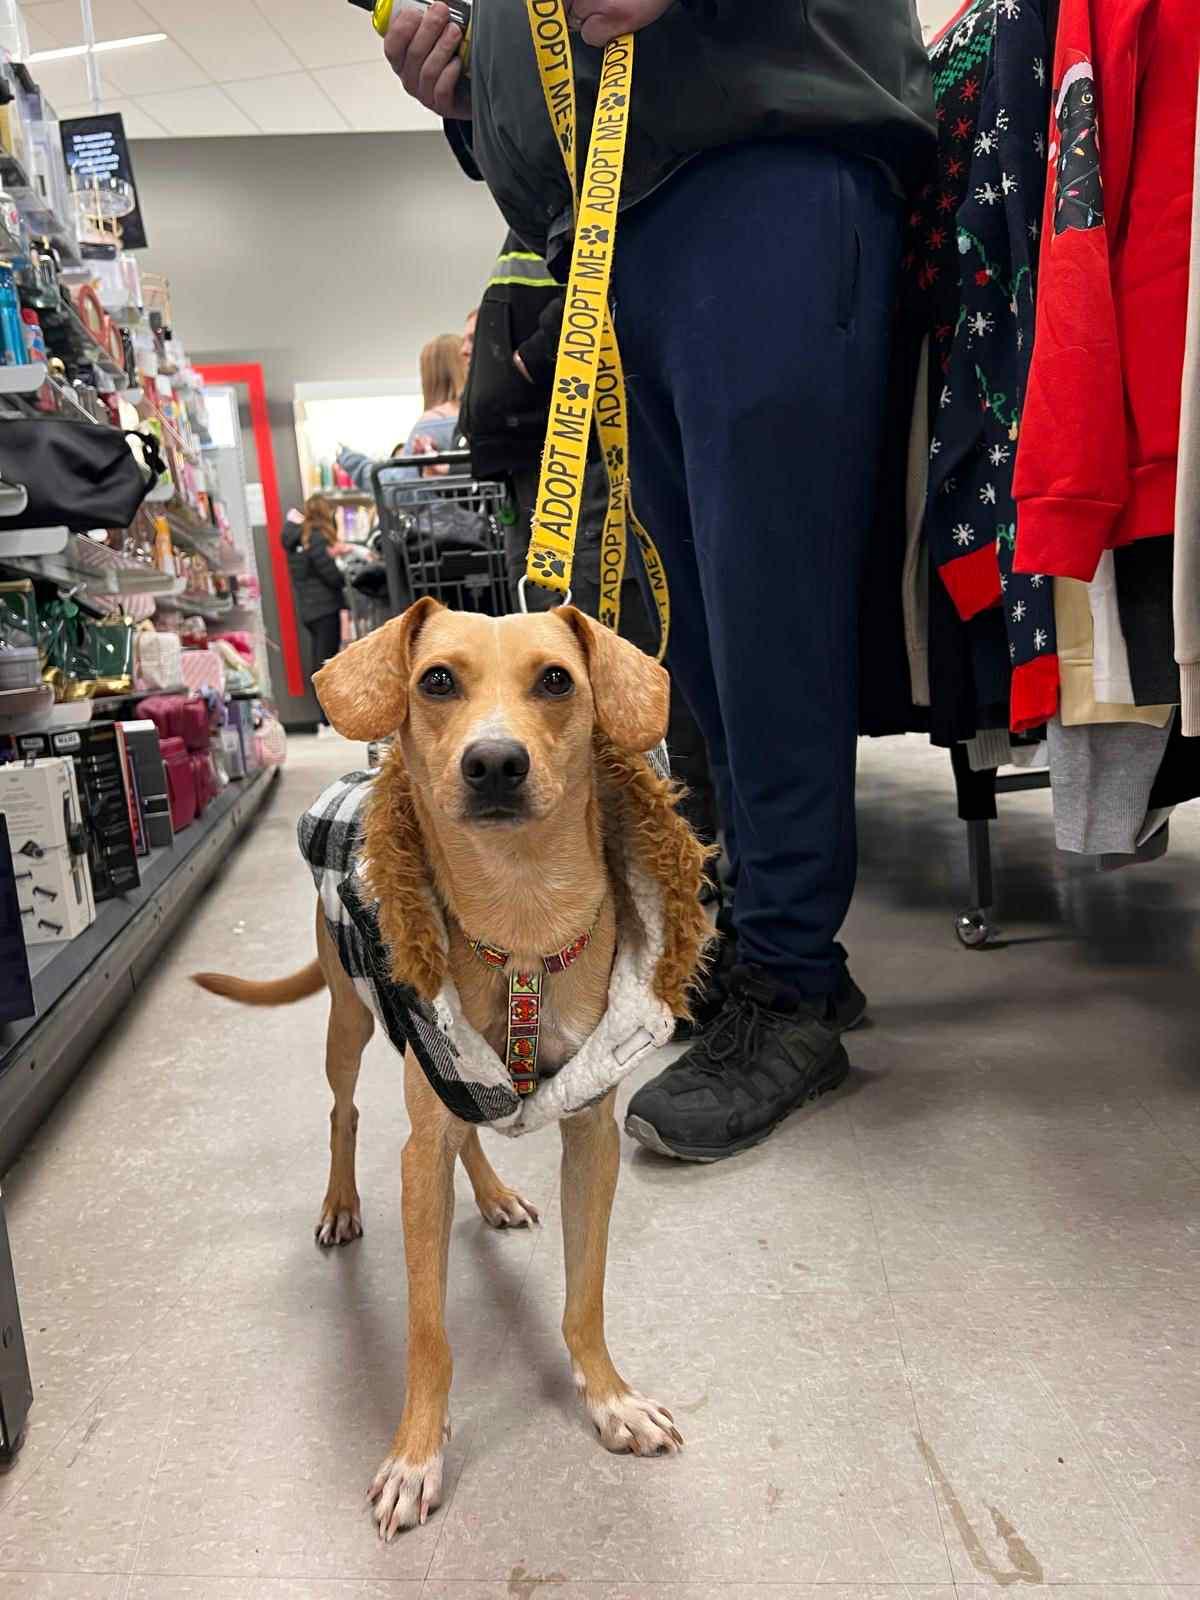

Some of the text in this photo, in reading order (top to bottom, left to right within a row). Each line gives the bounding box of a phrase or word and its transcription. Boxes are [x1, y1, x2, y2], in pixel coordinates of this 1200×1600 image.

[531, 0, 573, 125] DOPT ME
[540, 40, 628, 541] ADOPT ME ADOPT ME ADOPT ME ADOP
[610, 474, 623, 510] ME
[603, 519, 622, 602] ADOPT
[644, 556, 664, 590] ME
